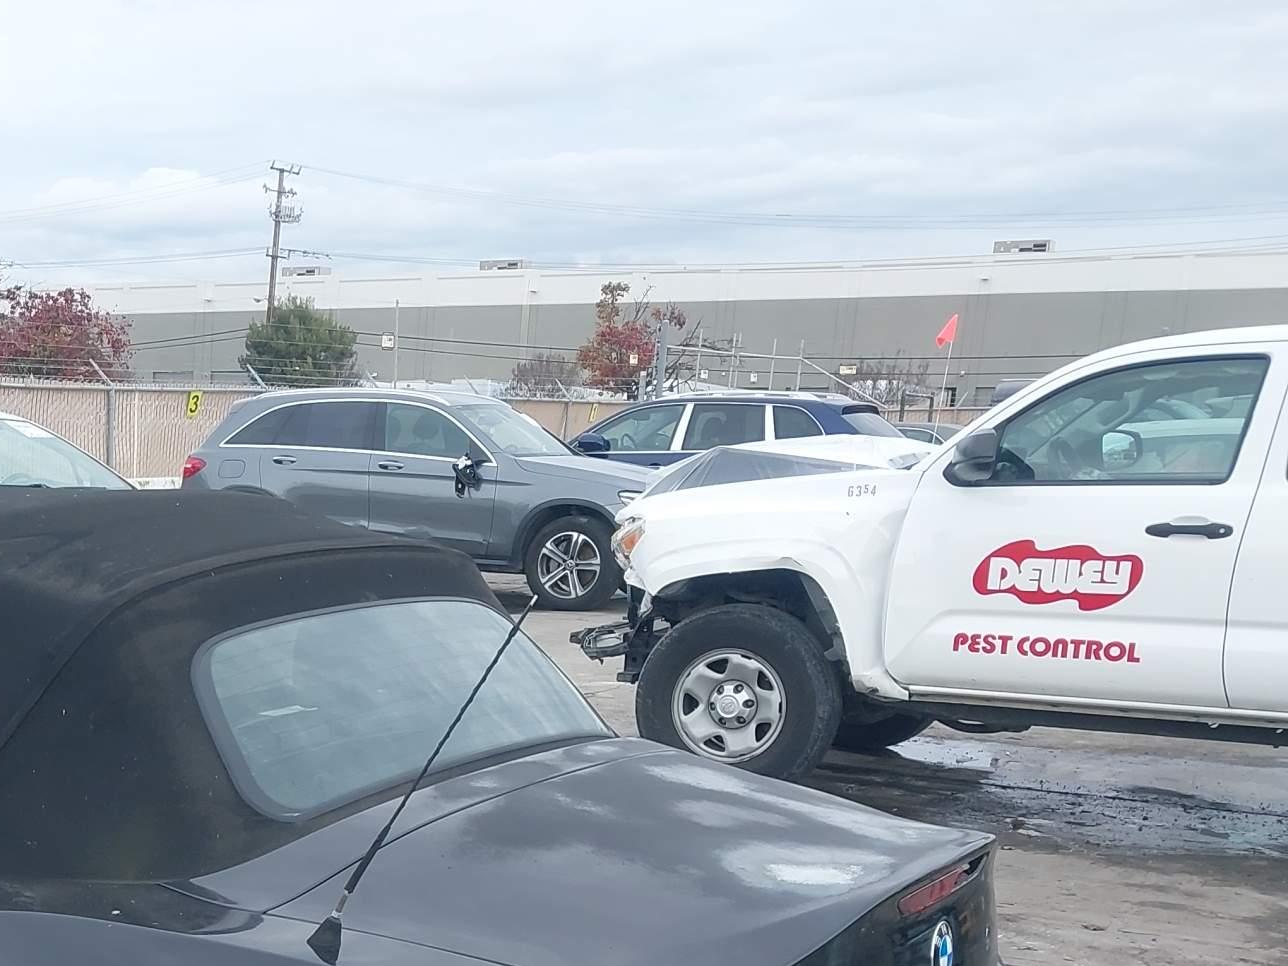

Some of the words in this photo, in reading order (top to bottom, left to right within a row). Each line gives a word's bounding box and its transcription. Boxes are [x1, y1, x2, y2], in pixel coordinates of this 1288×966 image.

[189, 395, 200, 413] 3
[987, 556, 1133, 595] DEWEY
[952, 632, 1014, 655] PEST
[1016, 636, 1142, 664] CONTROL
